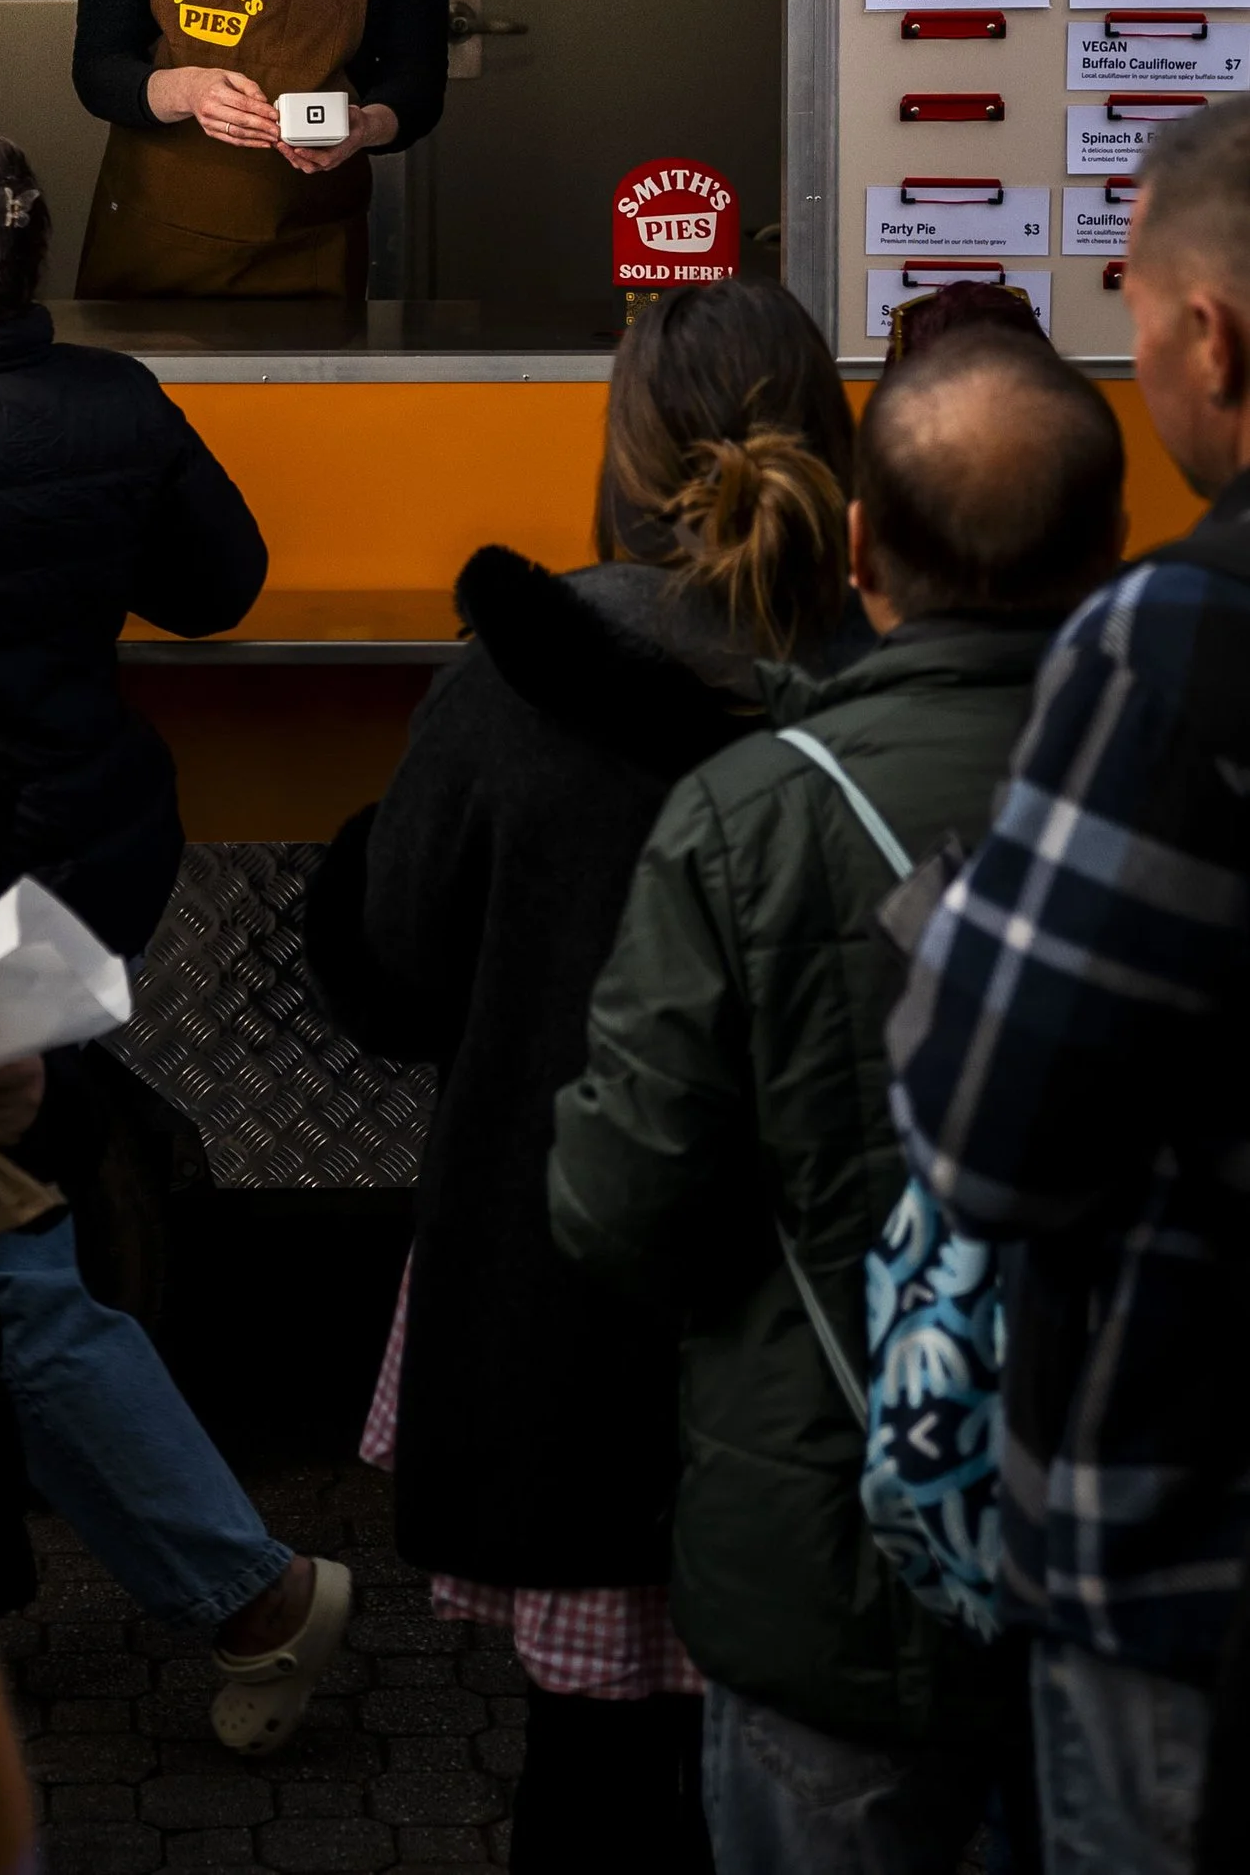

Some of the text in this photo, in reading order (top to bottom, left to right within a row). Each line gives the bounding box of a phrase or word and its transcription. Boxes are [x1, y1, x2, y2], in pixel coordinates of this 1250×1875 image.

[184, 10, 241, 35] PIES
[1083, 41, 1127, 52] VEGAN
[1083, 58, 1197, 69] Buffalo Cauliflower
[1226, 59, 1241, 71] $7
[1082, 132, 1130, 145] Spinach
[1134, 132, 1144, 143] &
[618, 169, 731, 218] SMITH'S
[1077, 214, 1132, 225] Cauliflow
[645, 219, 711, 242] PIES
[882, 223, 935, 236] Party Pie
[1025, 224, 1039, 236] $3
[619, 264, 670, 279] SOLD
[675, 266, 724, 280] HERE
